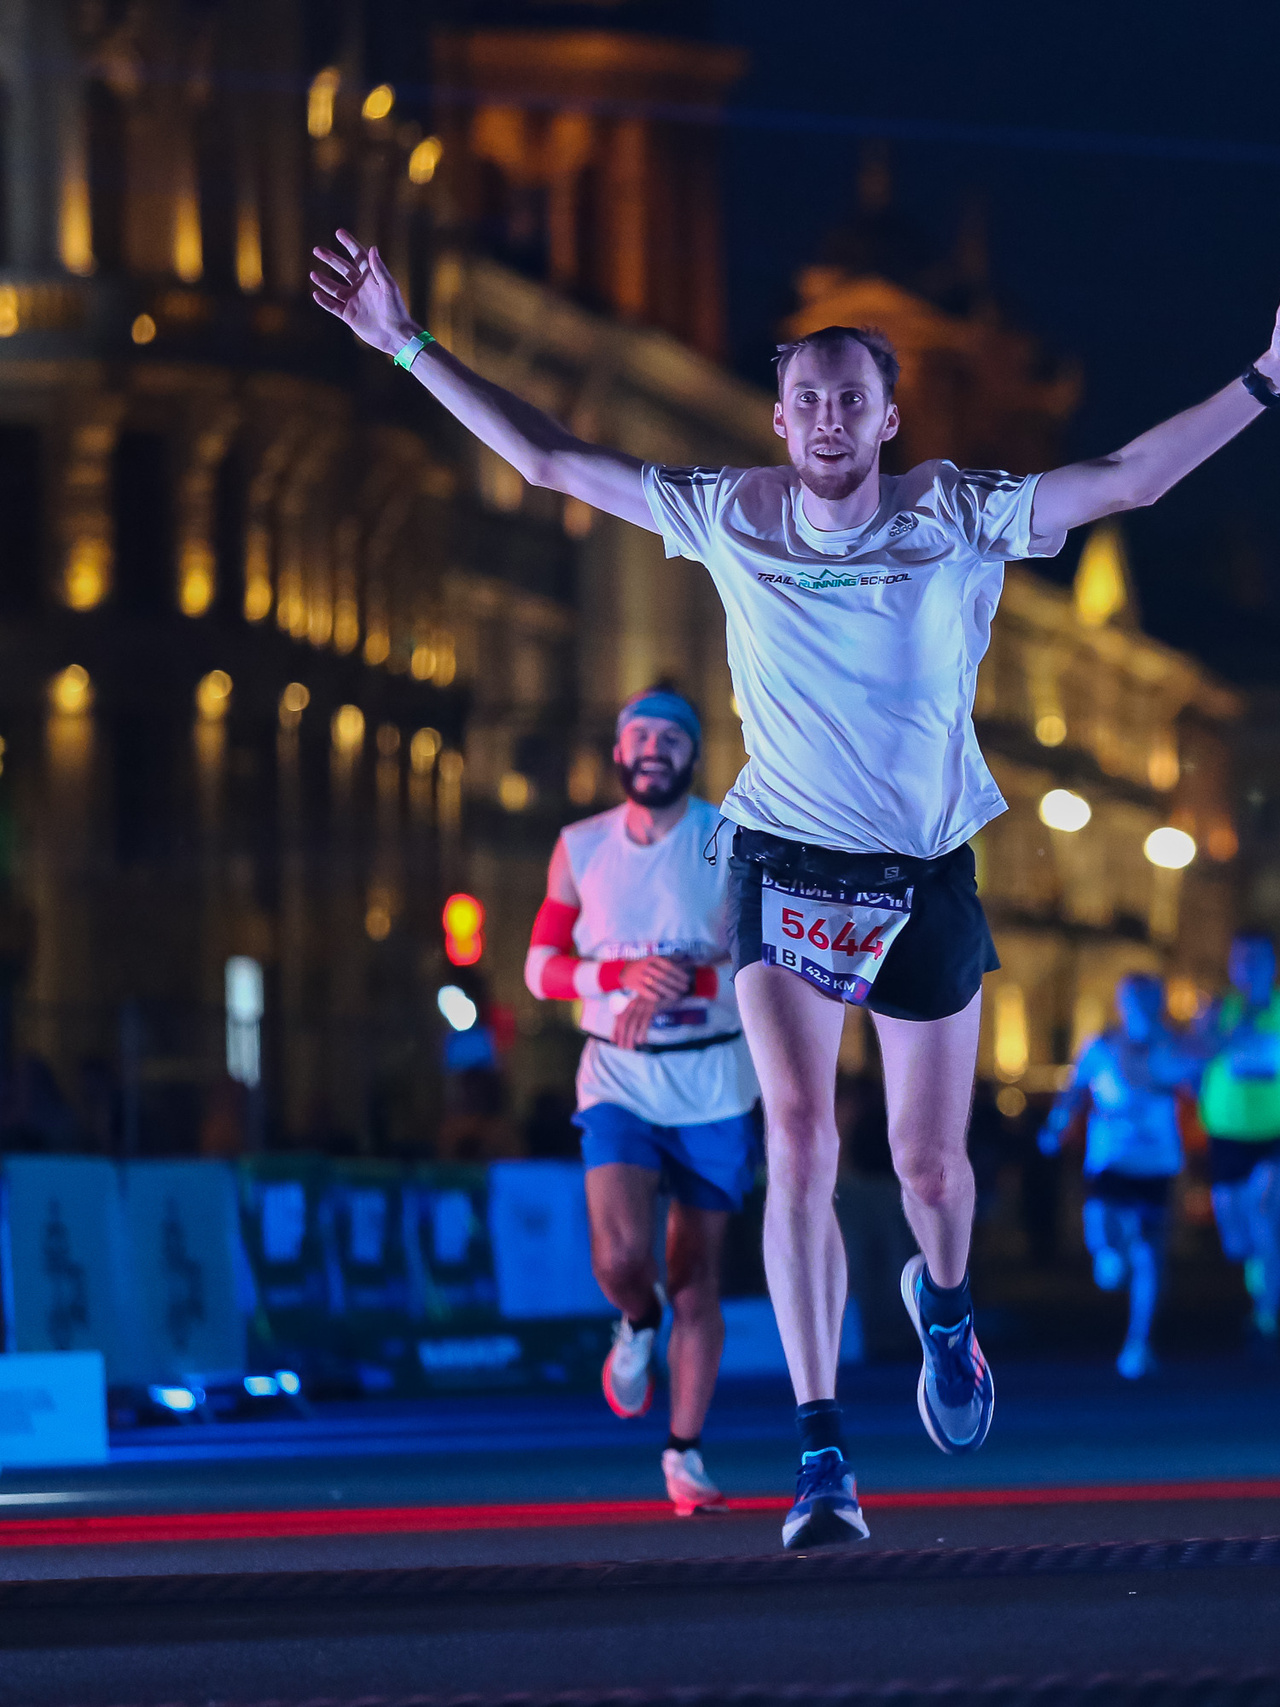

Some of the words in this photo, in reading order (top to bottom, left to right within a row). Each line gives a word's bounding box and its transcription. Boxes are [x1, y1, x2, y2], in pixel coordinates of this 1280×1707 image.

[757, 572, 795, 586] TRAIL
[796, 578, 858, 590] RUNNING
[859, 573, 912, 586] SCHOOL
[782, 907, 884, 960] 5644
[782, 949, 796, 966] B
[805, 965, 831, 986] 42,2
[833, 979, 856, 992] KM
